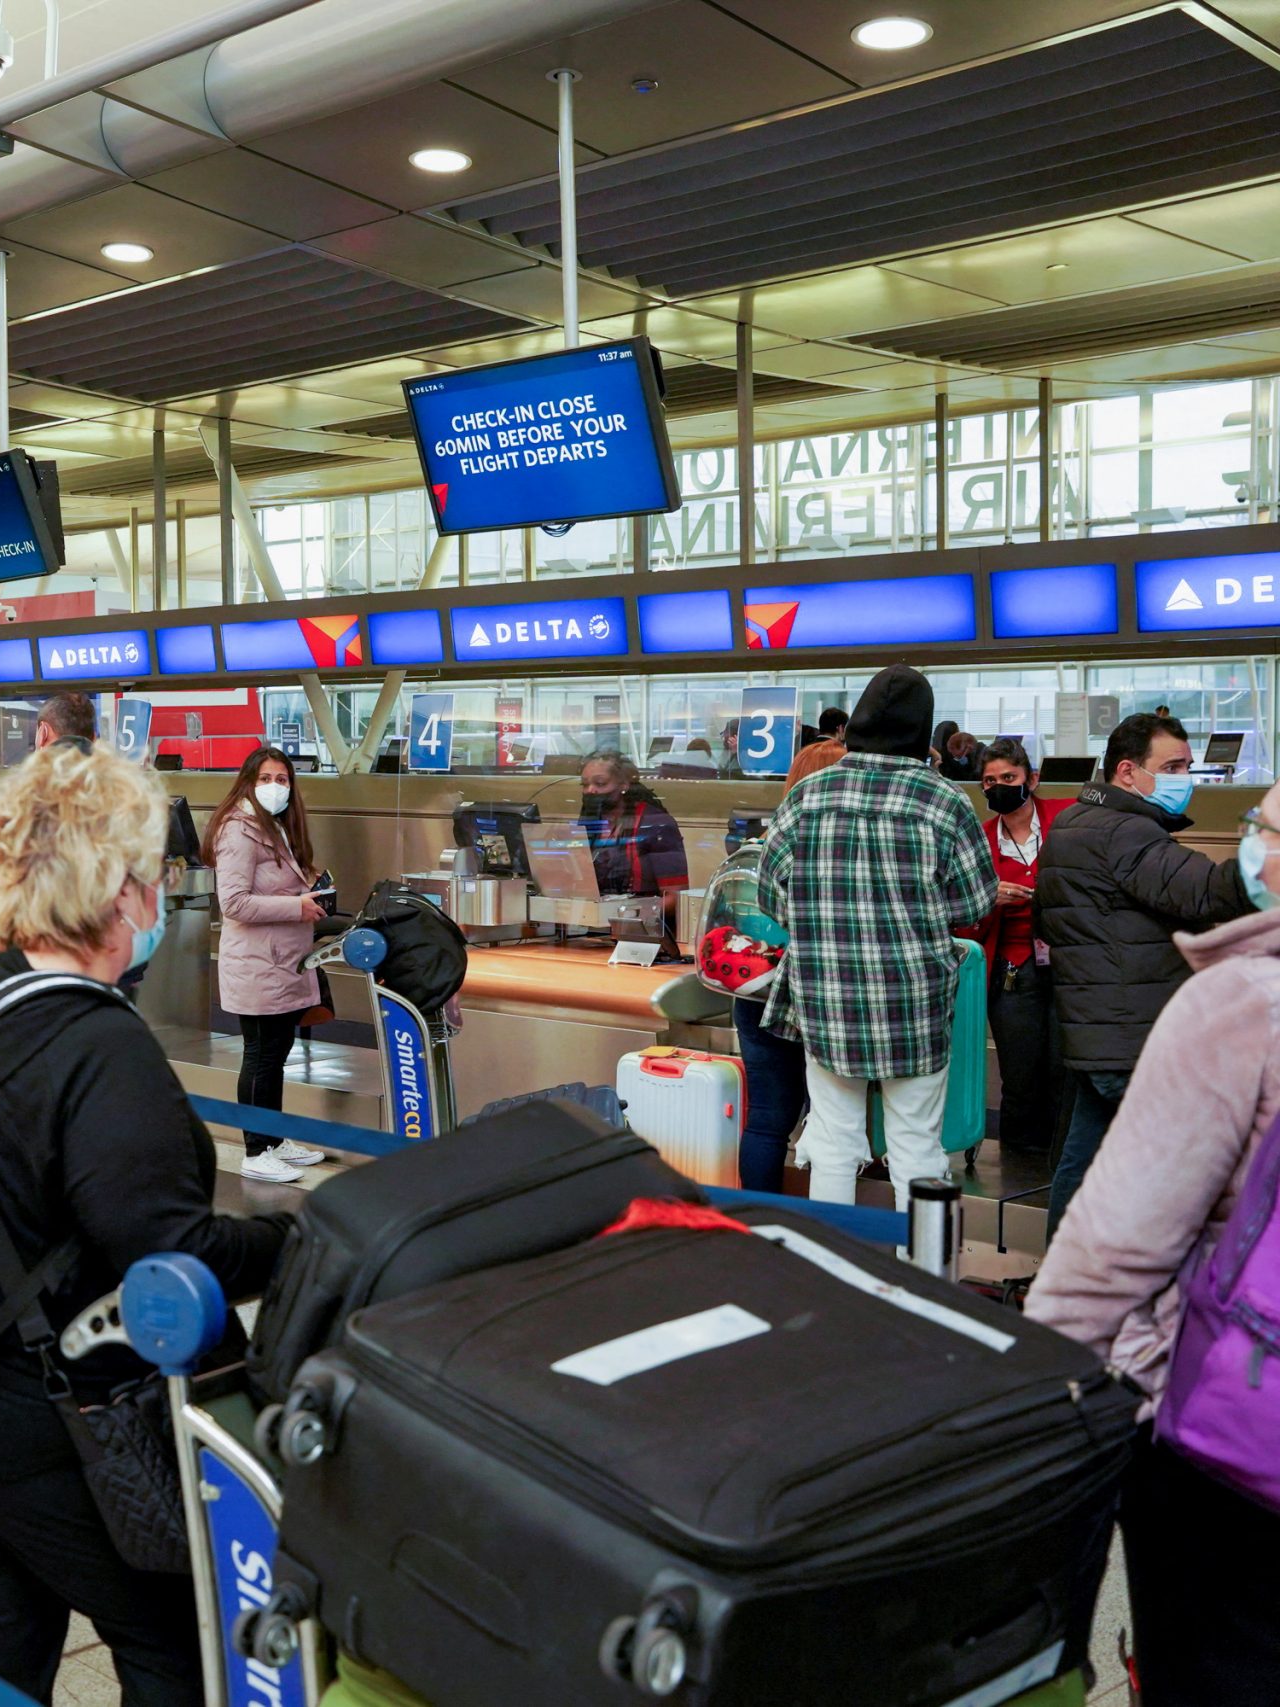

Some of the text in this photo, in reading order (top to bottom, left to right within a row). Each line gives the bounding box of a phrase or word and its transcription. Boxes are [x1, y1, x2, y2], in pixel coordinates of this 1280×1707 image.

[597, 349, 633, 362] 11:37 am
[415, 384, 438, 395] DELTA
[451, 394, 597, 433] CHECK-IN CLOSE
[434, 414, 628, 457] 60MIN BEFORE YOUR
[460, 440, 608, 475] FLIGHT DEPARTS
[495, 619, 583, 644] DELTA
[65, 646, 122, 666] DELTA
[120, 716, 136, 751] 5
[418, 713, 441, 756] 4
[748, 709, 775, 758] 3
